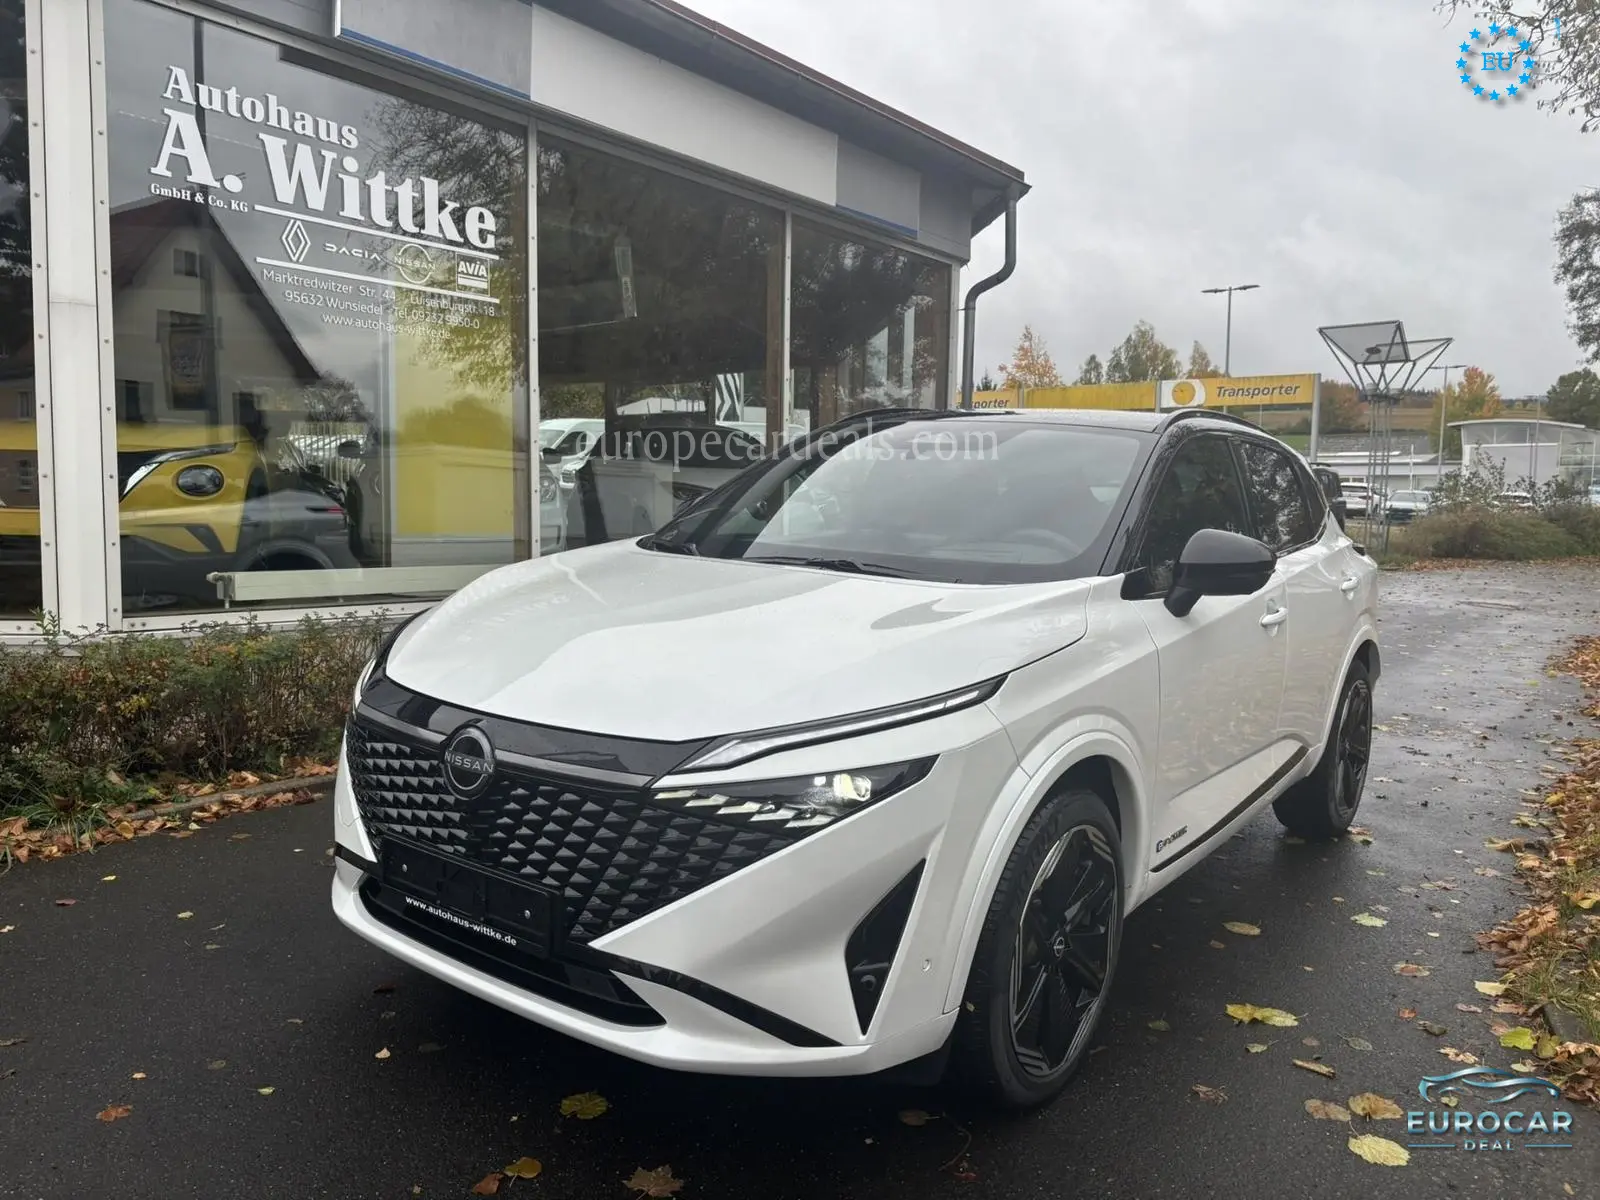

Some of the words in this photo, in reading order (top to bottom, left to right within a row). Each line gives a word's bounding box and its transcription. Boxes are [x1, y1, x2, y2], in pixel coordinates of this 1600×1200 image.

[163, 65, 359, 149] Autohaus
[150, 107, 243, 193] A.
[258, 132, 497, 249] Wittke
[150, 182, 191, 201] GmbH
[194, 192, 205, 204] &
[208, 194, 228, 209] Co.
[230, 199, 249, 213] KG
[323, 242, 382, 262] DACIA
[394, 255, 436, 271] NISSAN
[263, 268, 352, 294] Marktredwitzer
[359, 285, 378, 298] Str.
[382, 289, 396, 301] 44
[483, 305, 496, 317] 18
[285, 289, 324, 306] 95632
[325, 296, 384, 315] Wunsiedel
[411, 309, 445, 325] 09232
[1216, 384, 1300, 399] Transporter
[445, 751, 494, 773] NISSAN
[405, 895, 517, 946] www.autohaus-wittke.de
